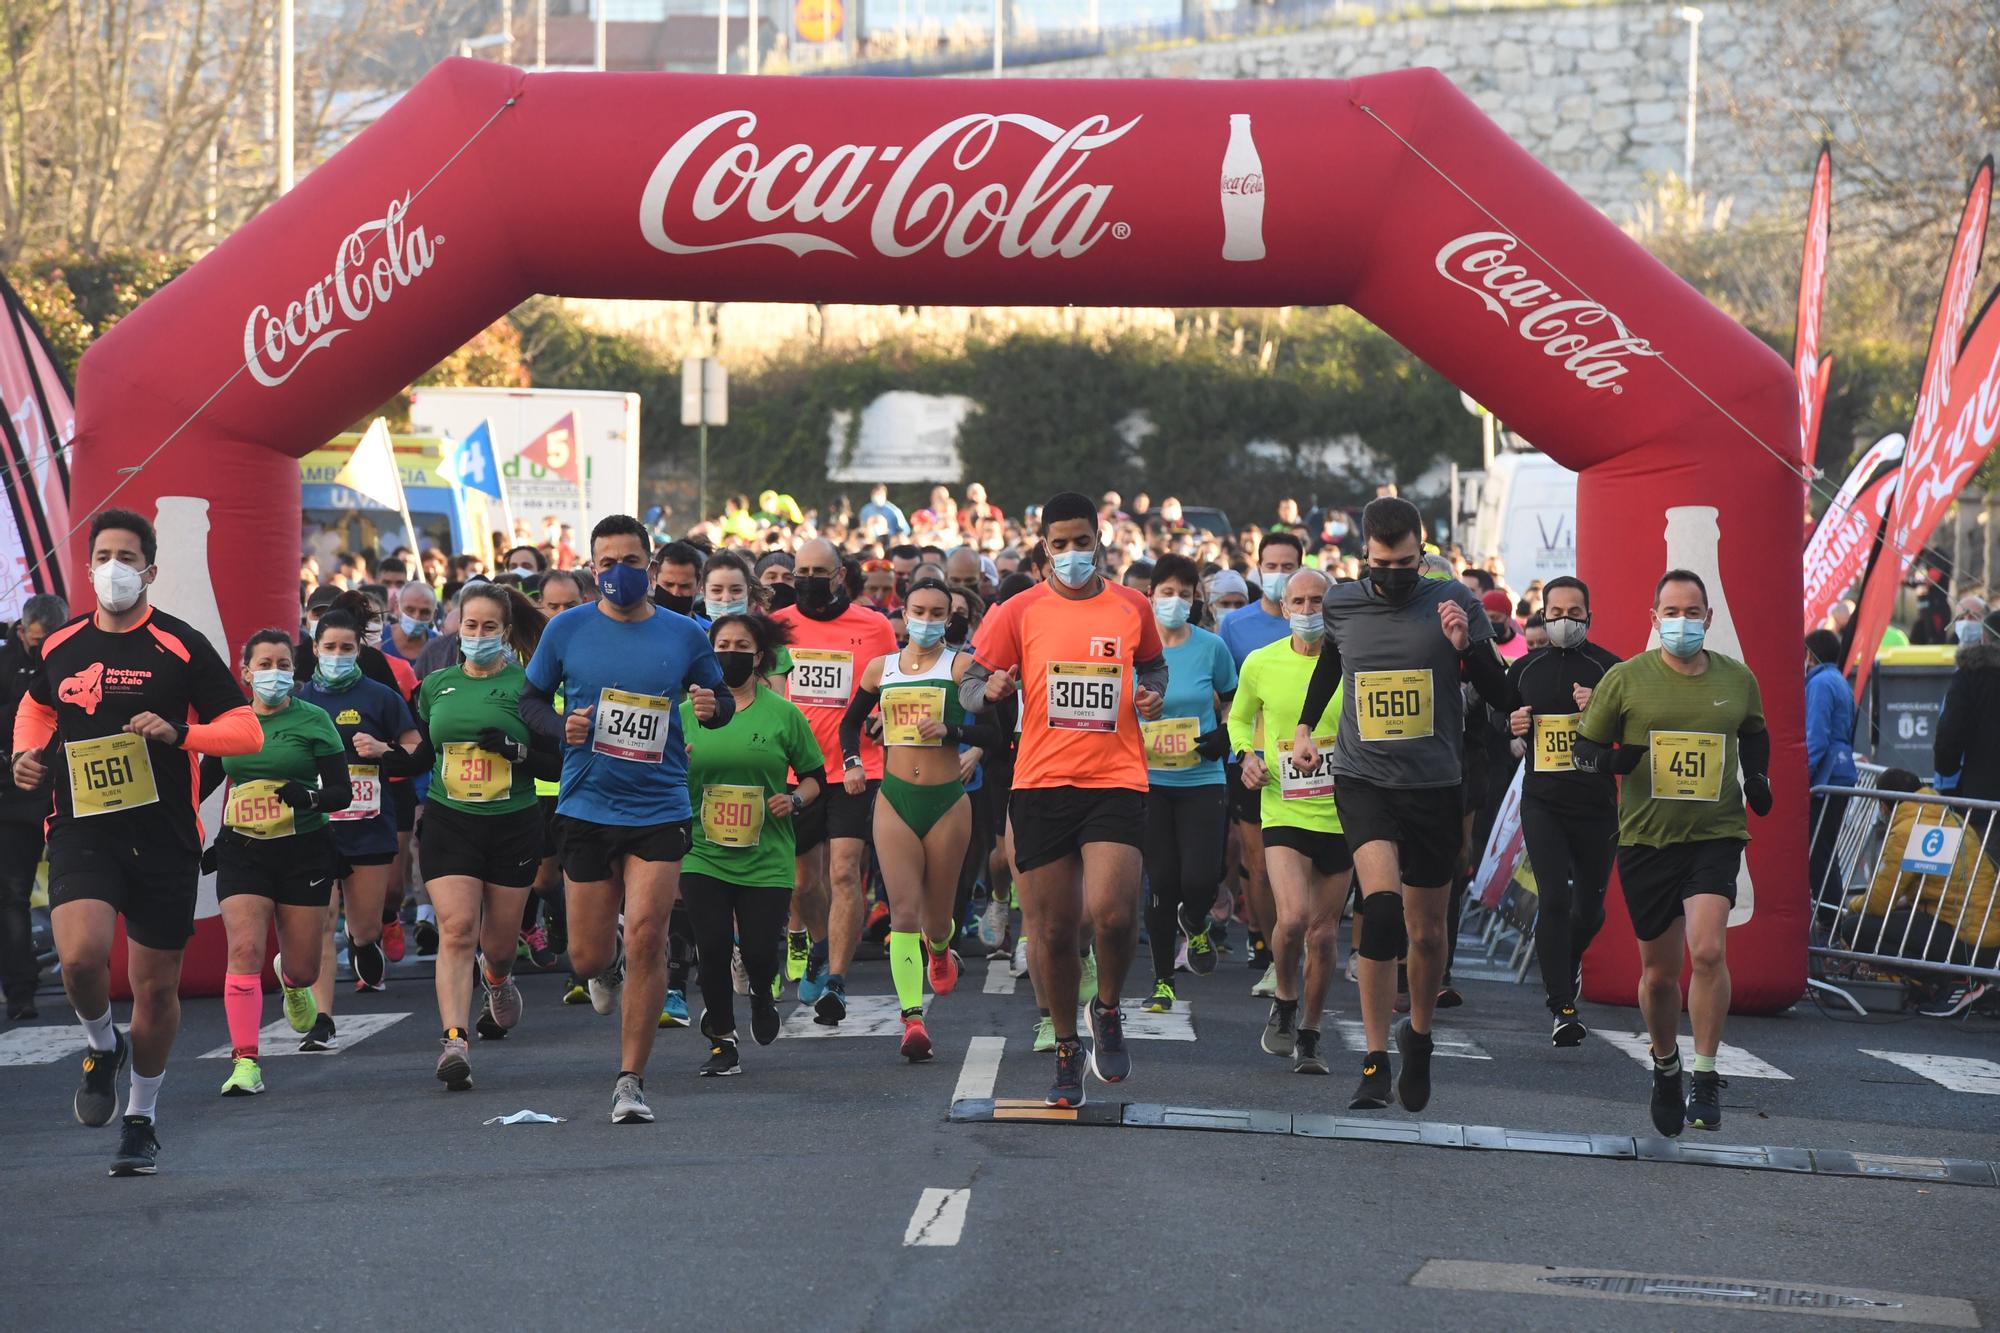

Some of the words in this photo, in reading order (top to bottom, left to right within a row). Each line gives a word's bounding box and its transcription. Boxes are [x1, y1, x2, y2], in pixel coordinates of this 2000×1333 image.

[639, 110, 1143, 260] Coca-Cola
[244, 190, 435, 387] Coca-Cola
[1435, 231, 1663, 389] Coca-Cola
[459, 441, 486, 483] 4
[546, 429, 570, 468] 5
[105, 676, 119, 684] do
[120, 677, 143, 685] Xalo
[106, 668, 152, 678] Nocturna
[799, 665, 842, 688] 3351
[1056, 681, 1114, 709] 3056
[1368, 690, 1420, 718] 1560
[608, 709, 660, 741] 3491
[891, 703, 932, 726] 1555
[1152, 733, 1187, 754] 496
[84, 755, 133, 790] 1561
[460, 758, 492, 782] 391
[1669, 751, 1706, 778] 451
[235, 796, 281, 824] 1556
[713, 801, 753, 827] 390
